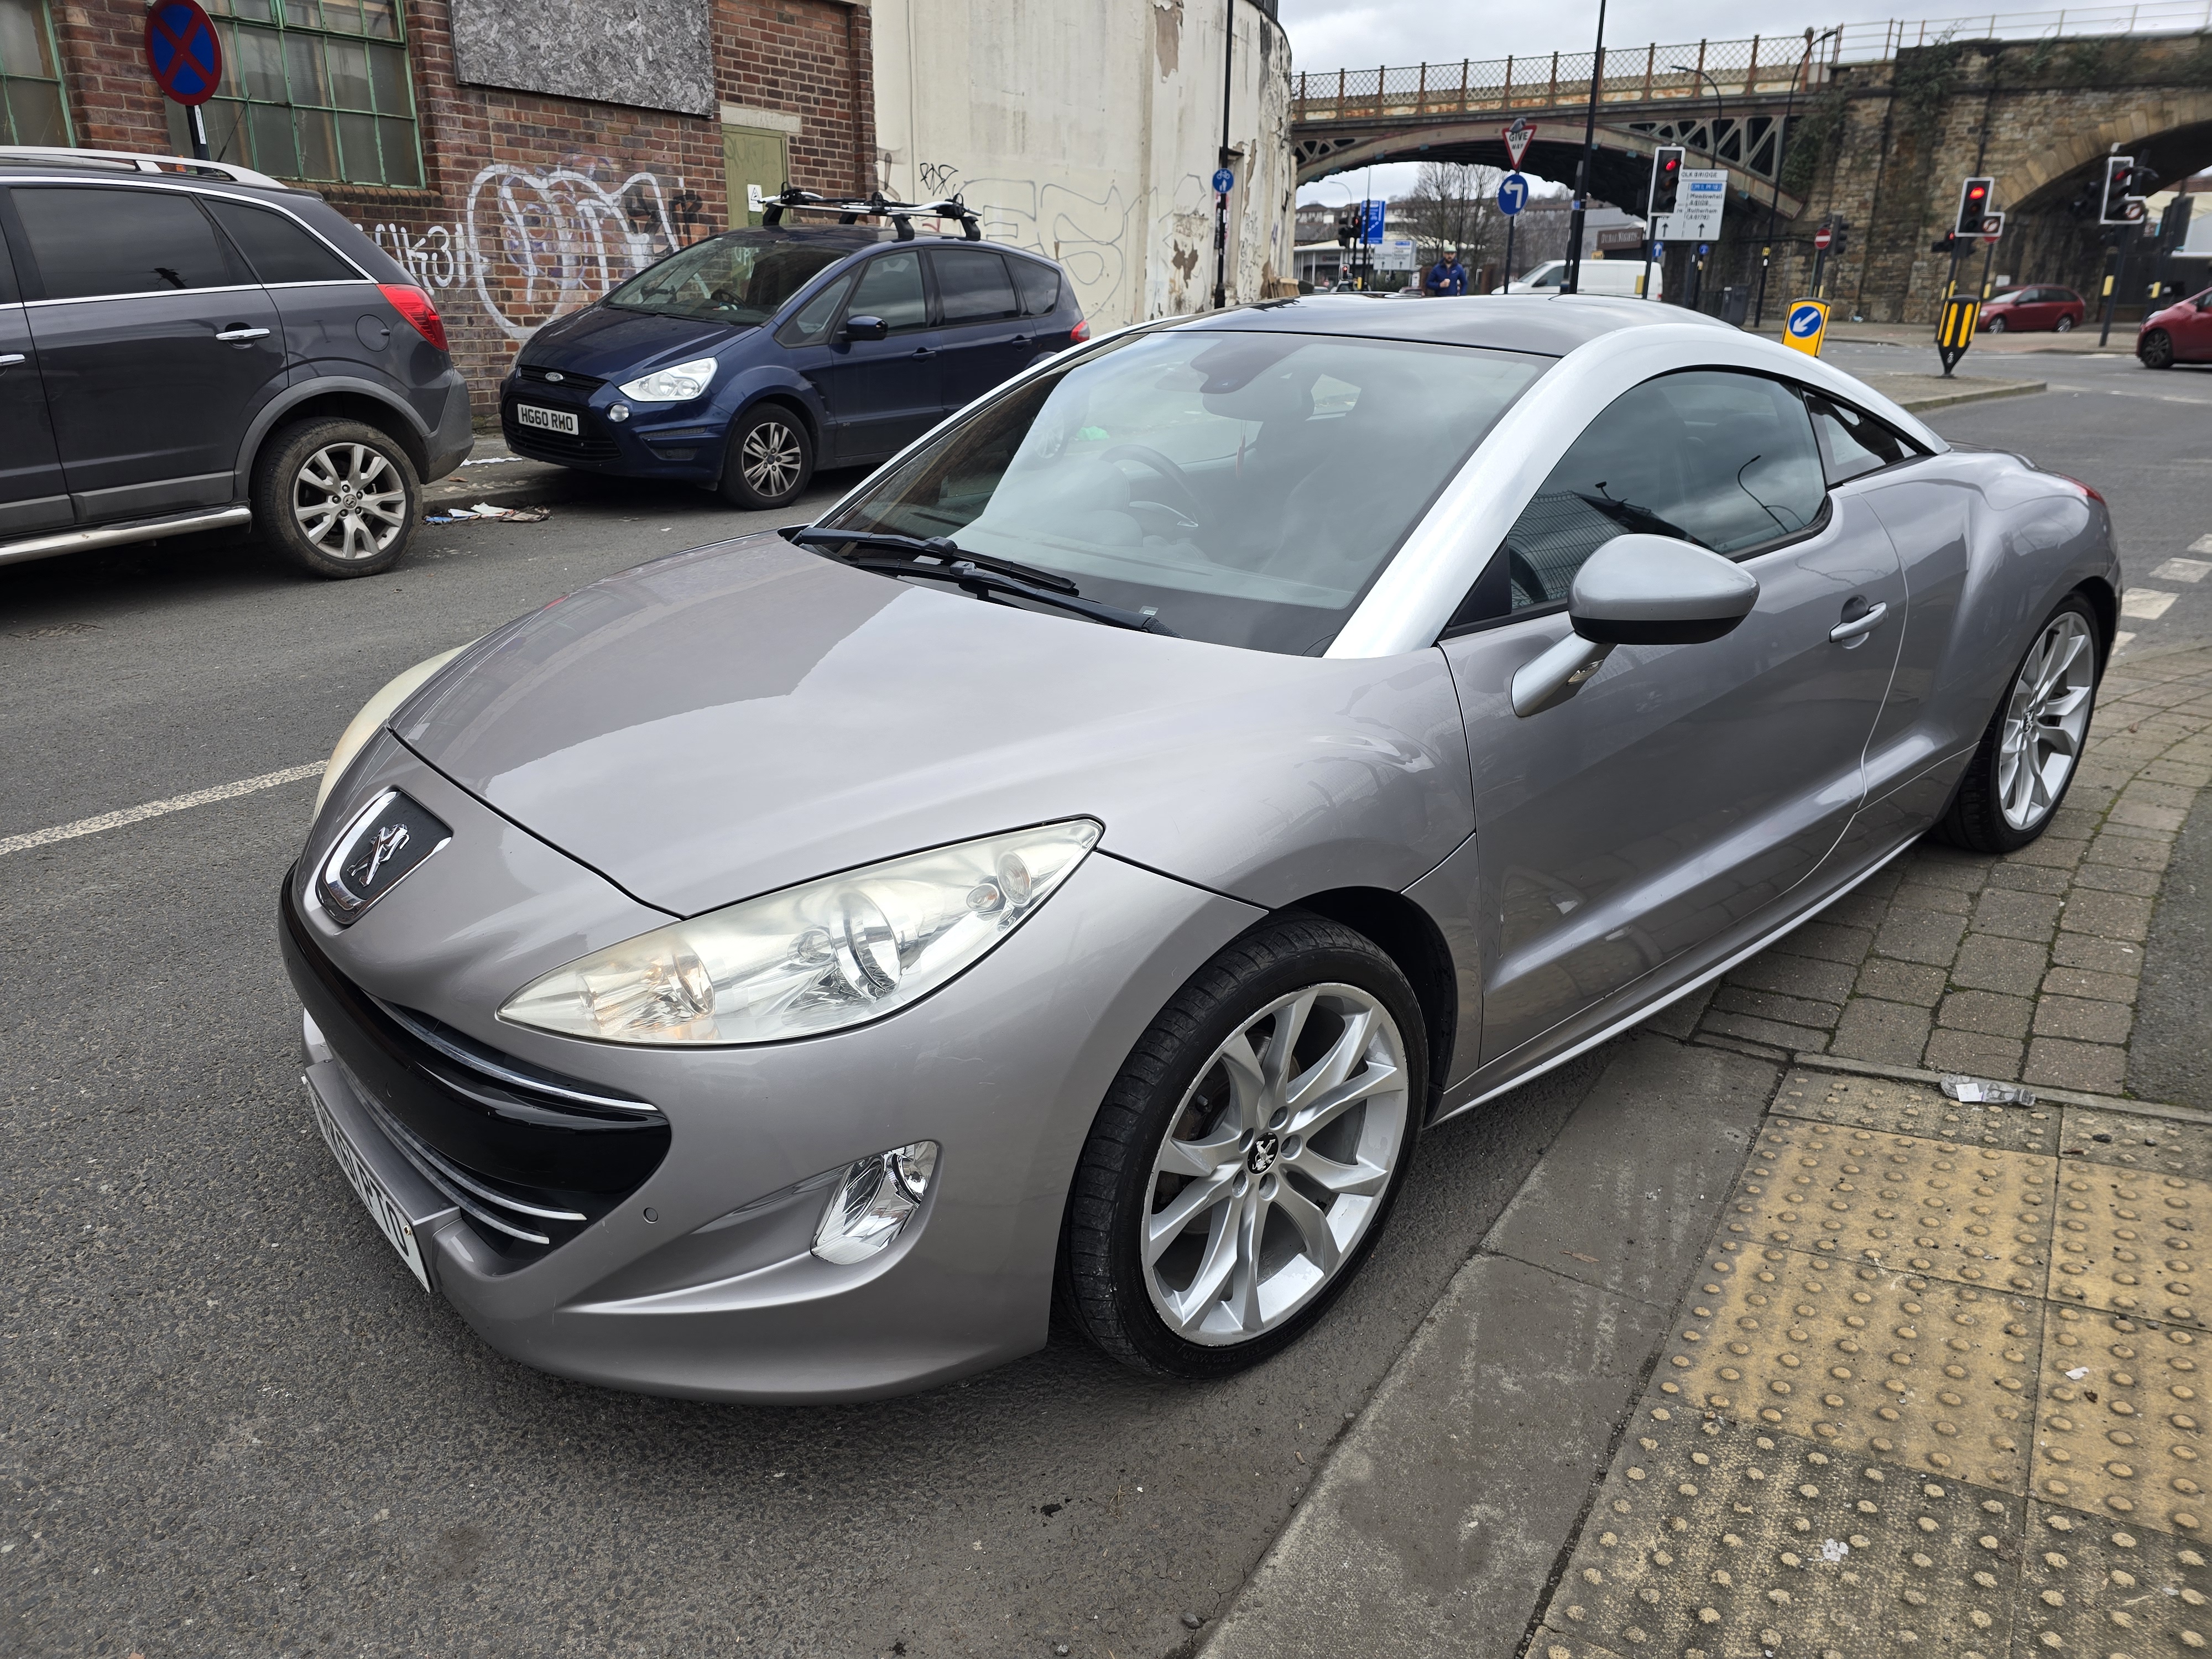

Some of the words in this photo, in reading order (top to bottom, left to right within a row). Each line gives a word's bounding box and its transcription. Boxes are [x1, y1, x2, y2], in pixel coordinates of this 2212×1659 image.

[1509, 132, 1528, 142] GIVE
[521, 407, 549, 426] HG60
[551, 413, 573, 431] RHO
[354, 1157, 409, 1257] PTO
